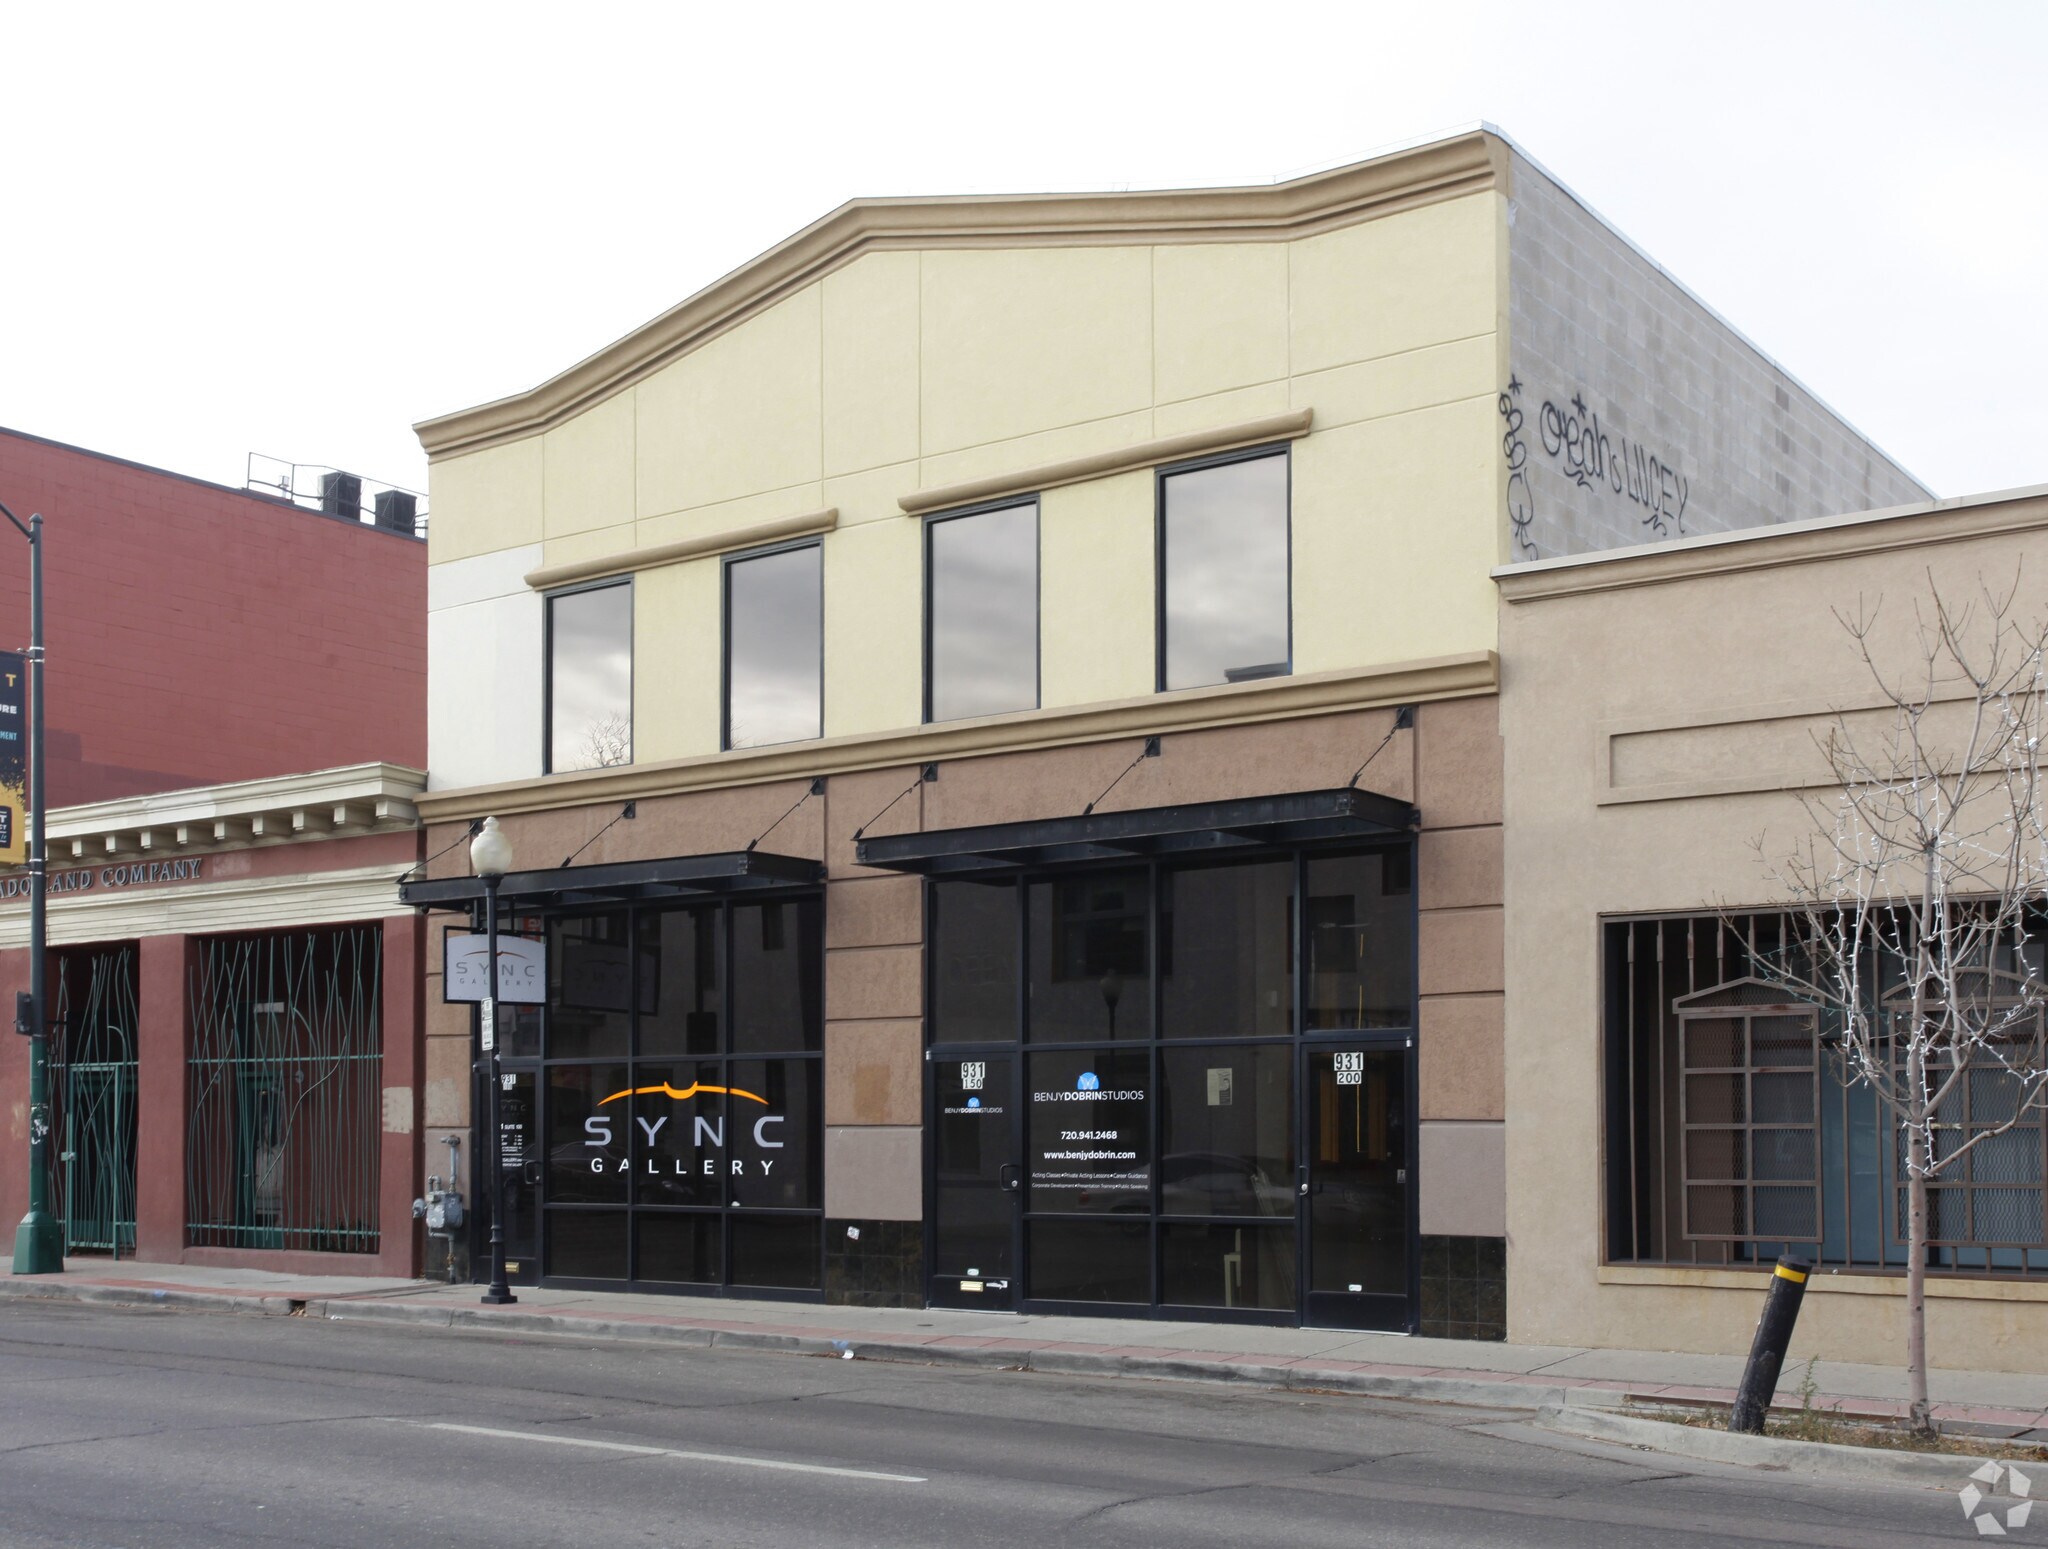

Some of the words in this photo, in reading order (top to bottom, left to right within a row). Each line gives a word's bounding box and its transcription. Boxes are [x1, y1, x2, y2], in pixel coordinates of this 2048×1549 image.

[5, 673, 17, 687] T
[101, 858, 201, 888] COMPANY
[456, 962, 535, 977] SYNC
[459, 978, 533, 986] GALERY
[1335, 1053, 1361, 1070] 931
[962, 1062, 984, 1078] 931
[964, 1079, 982, 1089] 150
[1338, 1072, 1361, 1084] 200
[1034, 1091, 1144, 1101] BENJYDOBRINSTUDIOS
[584, 1116, 784, 1147] SYNC
[1061, 1131, 1118, 1140] 720.941.2468
[1044, 1151, 1136, 1160] www.benjydobrin.com
[590, 1158, 774, 1175] GALLERY
